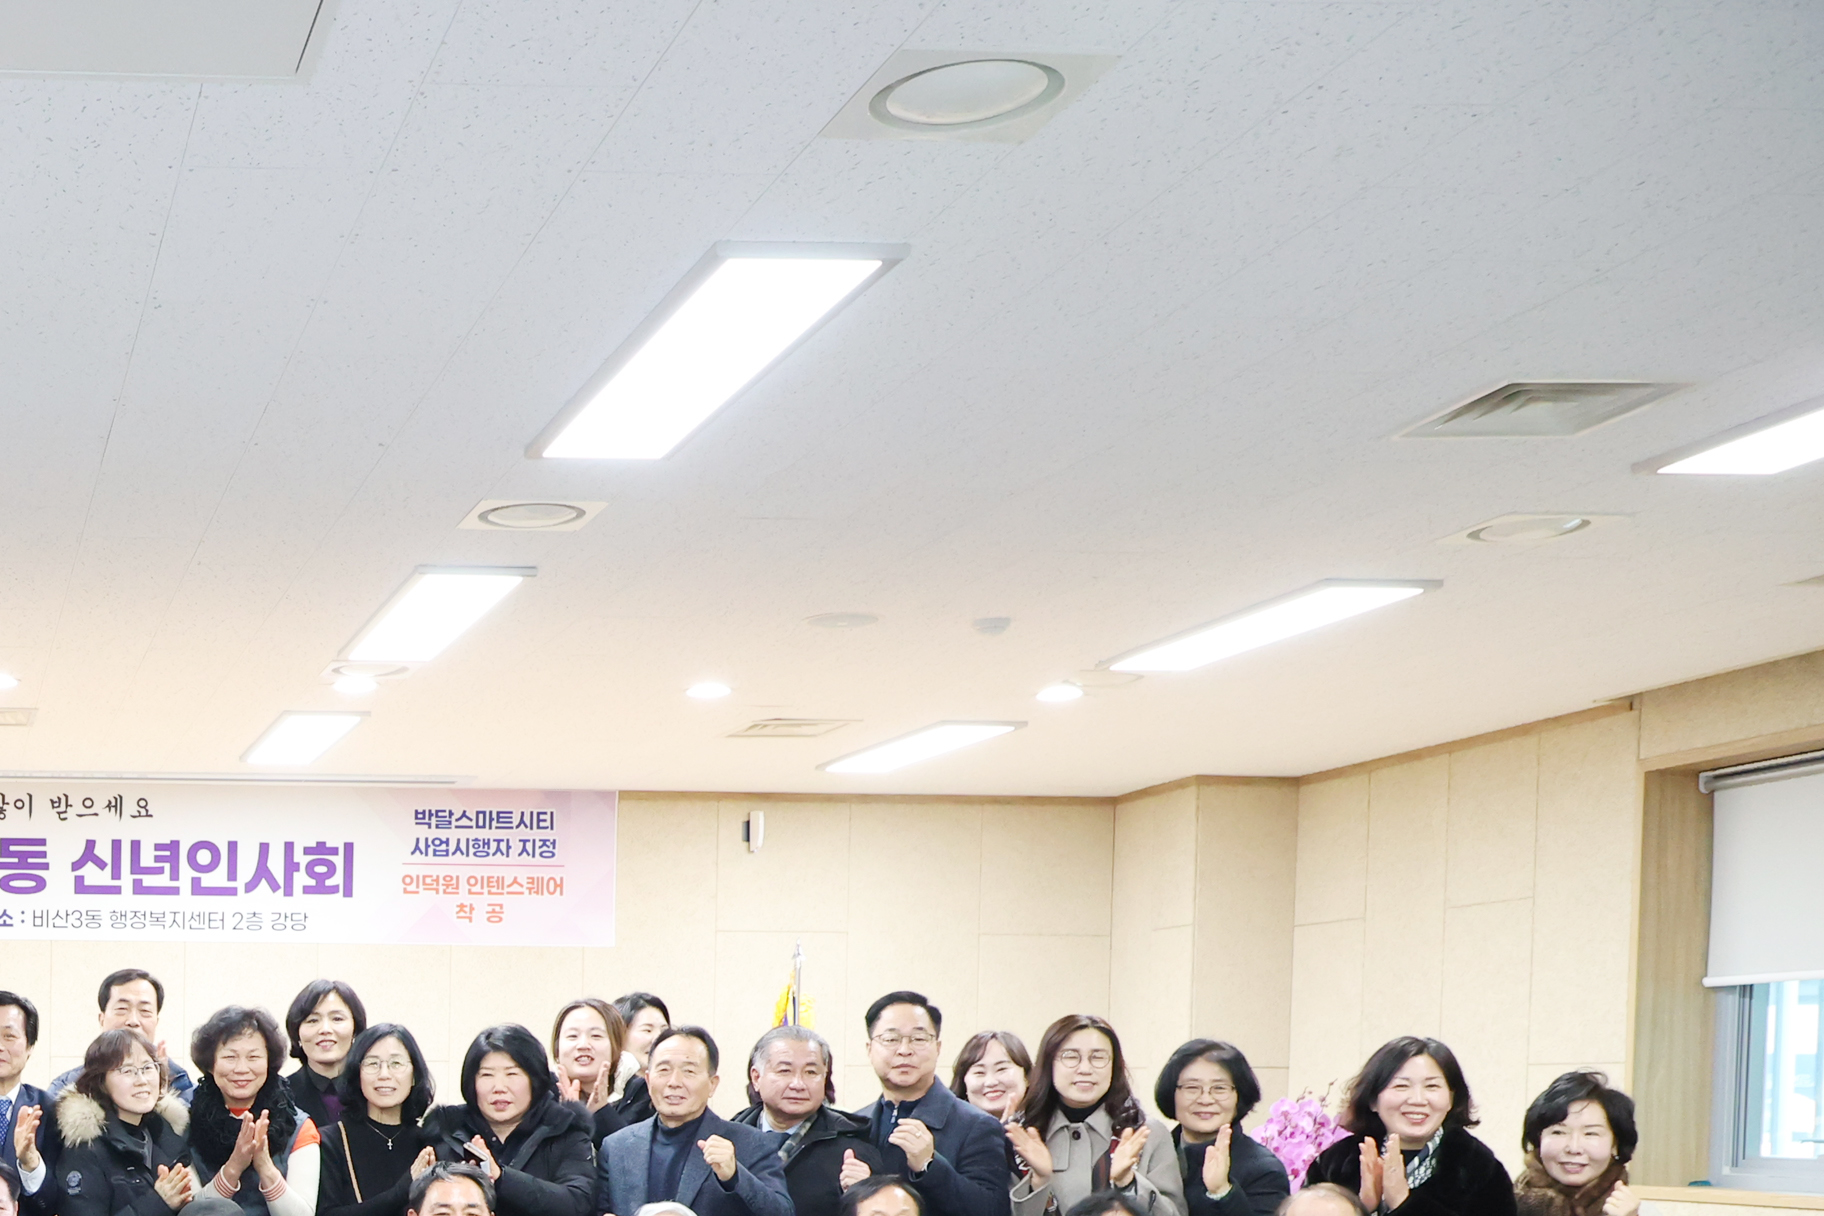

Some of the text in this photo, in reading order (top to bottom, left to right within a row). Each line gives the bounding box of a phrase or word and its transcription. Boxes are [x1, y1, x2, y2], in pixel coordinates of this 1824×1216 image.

[49, 793, 153, 821] 받으세요
[415, 809, 554, 830] 박달스마트시티
[411, 837, 556, 858] 사업시행자 지정
[71, 839, 354, 897] 신년인사회
[402, 874, 563, 896] 인덕원 인텐스퀘어
[33, 909, 102, 929] 비산3동
[110, 910, 224, 930] 행정복지센터
[232, 911, 263, 931] 2층
[271, 912, 308, 931] 강당
